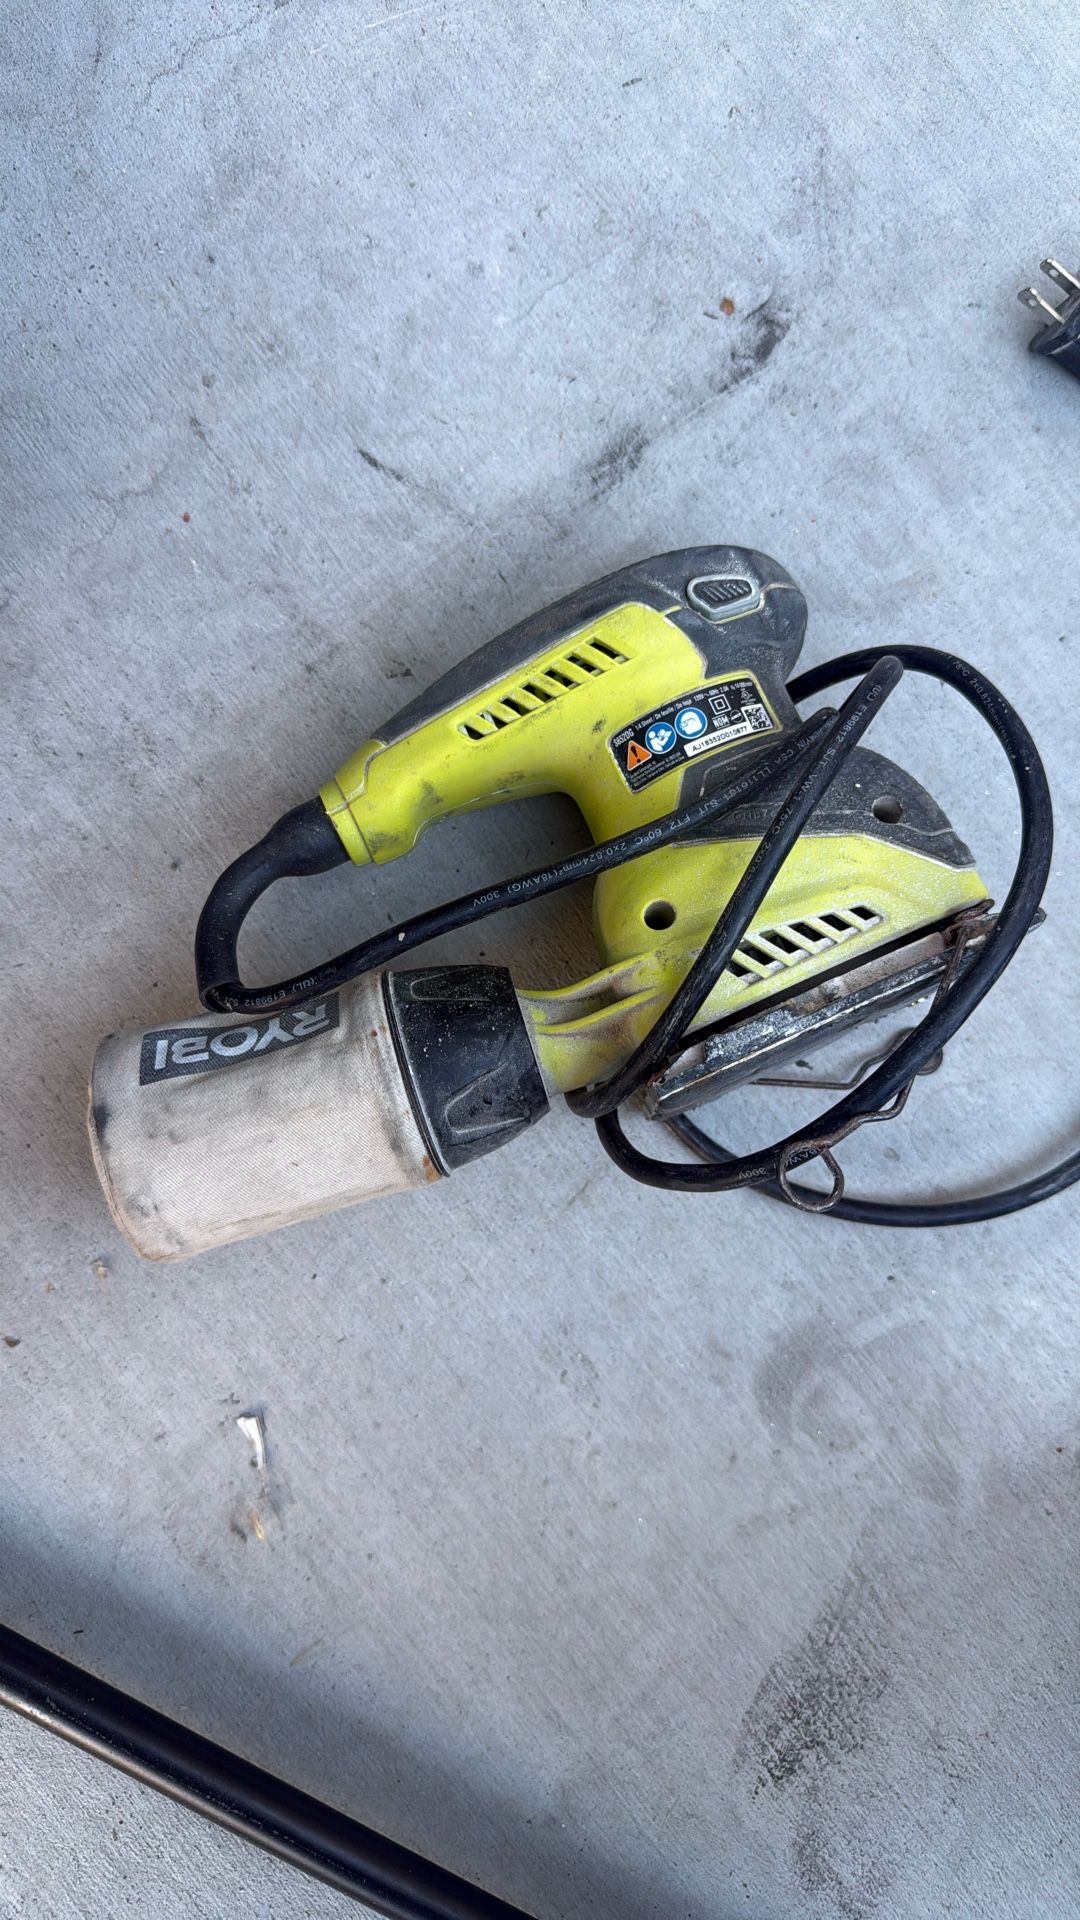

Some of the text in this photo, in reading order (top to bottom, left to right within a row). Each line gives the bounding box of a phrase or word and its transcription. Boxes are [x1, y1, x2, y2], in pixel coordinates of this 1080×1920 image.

[713, 716, 730, 727] NOM
[837, 705, 868, 743] E199812
[820, 749, 836, 768] SJT
[793, 774, 817, 801] VW-1
[669, 814, 691, 830] FT2
[473, 890, 500, 907] 300V
[154, 1003, 330, 1070] RYOBI
[738, 1167, 767, 1180] 300V
